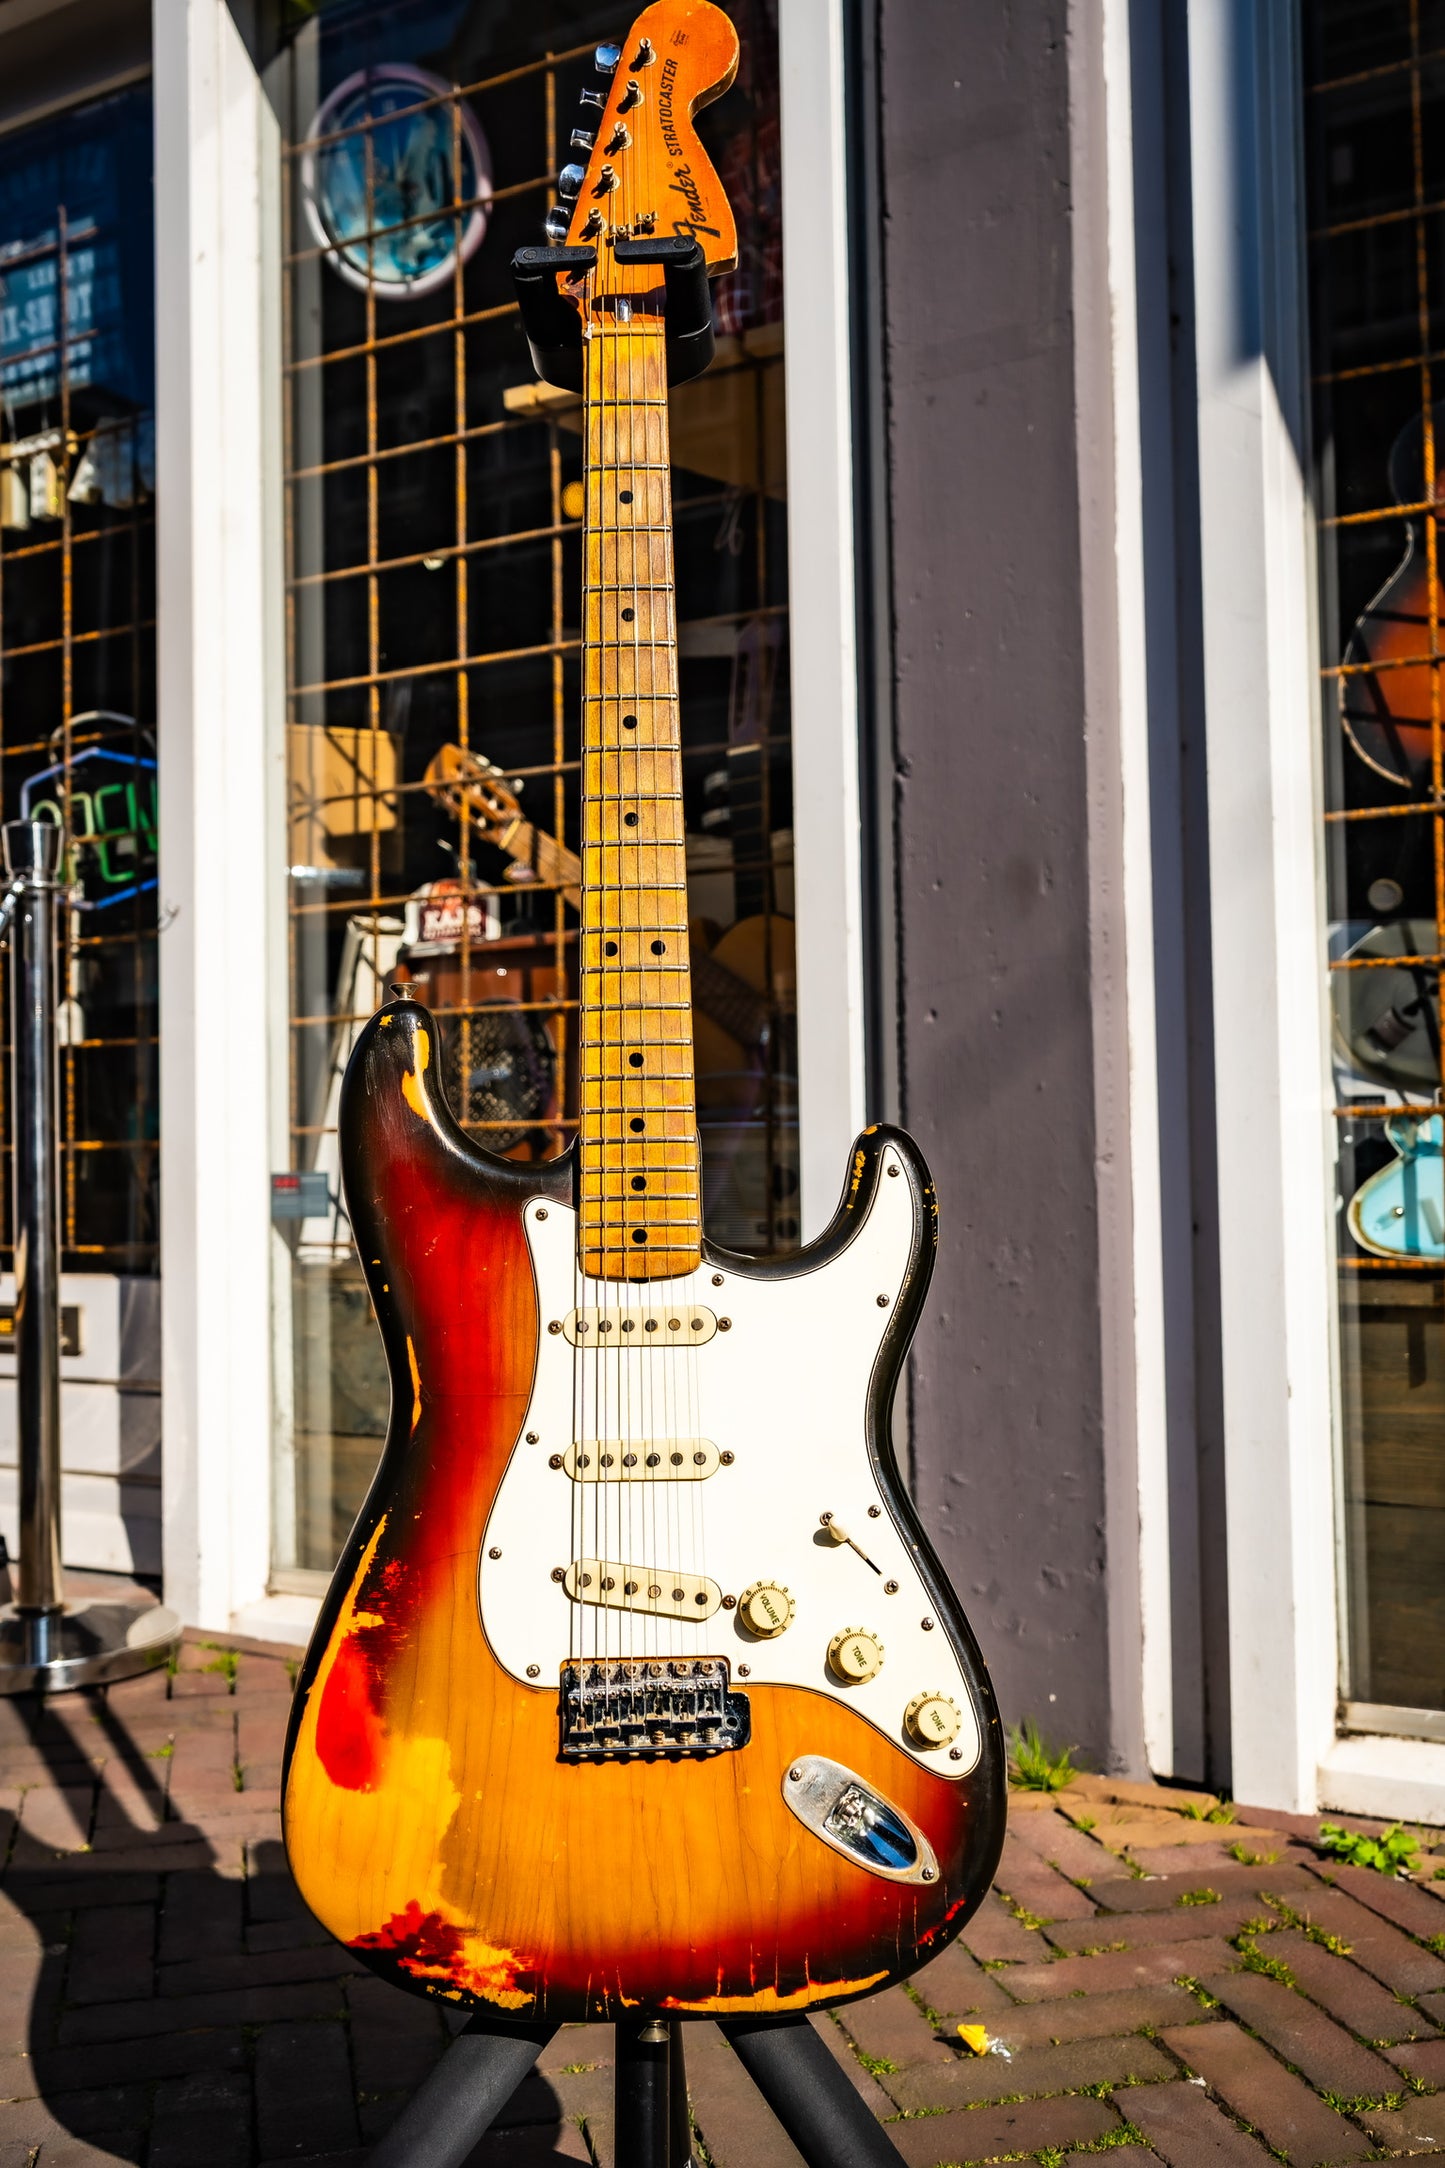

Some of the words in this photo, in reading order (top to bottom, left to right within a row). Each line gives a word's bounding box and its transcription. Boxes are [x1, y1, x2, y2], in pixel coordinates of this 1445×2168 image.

[658, 58, 683, 157] STRATOCASTER
[668, 163, 721, 239] Fender
[760, 1593, 780, 1625] VOLUME
[852, 1645, 867, 1668] TONE
[930, 1710, 946, 1732] TONE
